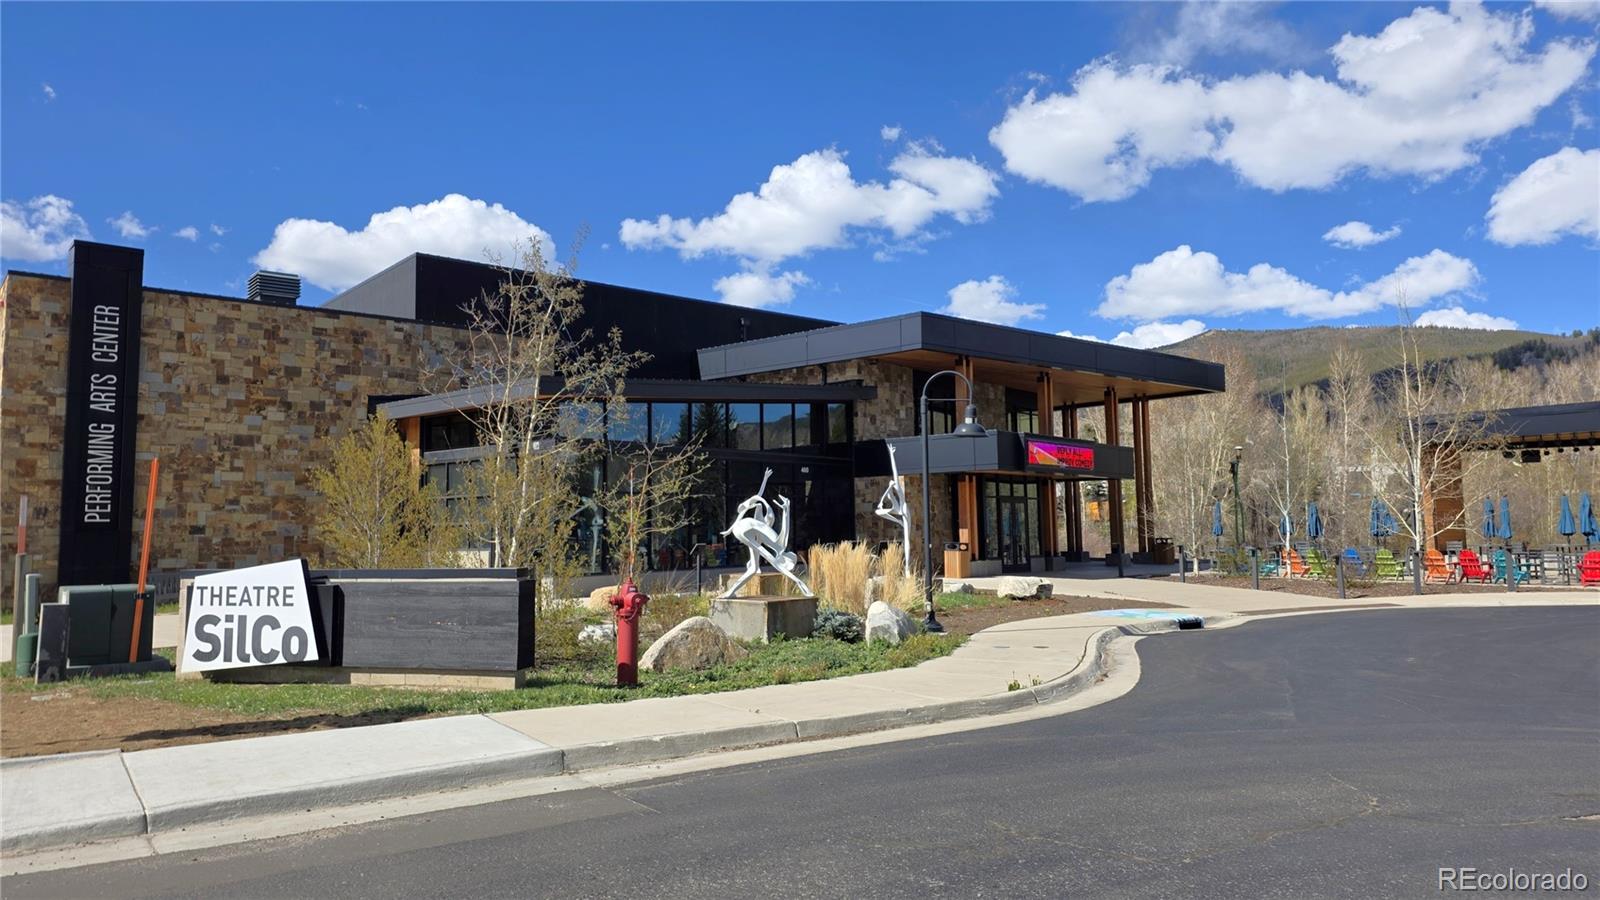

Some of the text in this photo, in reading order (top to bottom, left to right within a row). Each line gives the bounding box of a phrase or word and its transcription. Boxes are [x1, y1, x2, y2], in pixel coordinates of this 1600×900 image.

[84, 304, 120, 524] PERFORMING ARTS CENTER
[197, 586, 294, 607] THEATRE
[192, 614, 309, 664] SilCo
